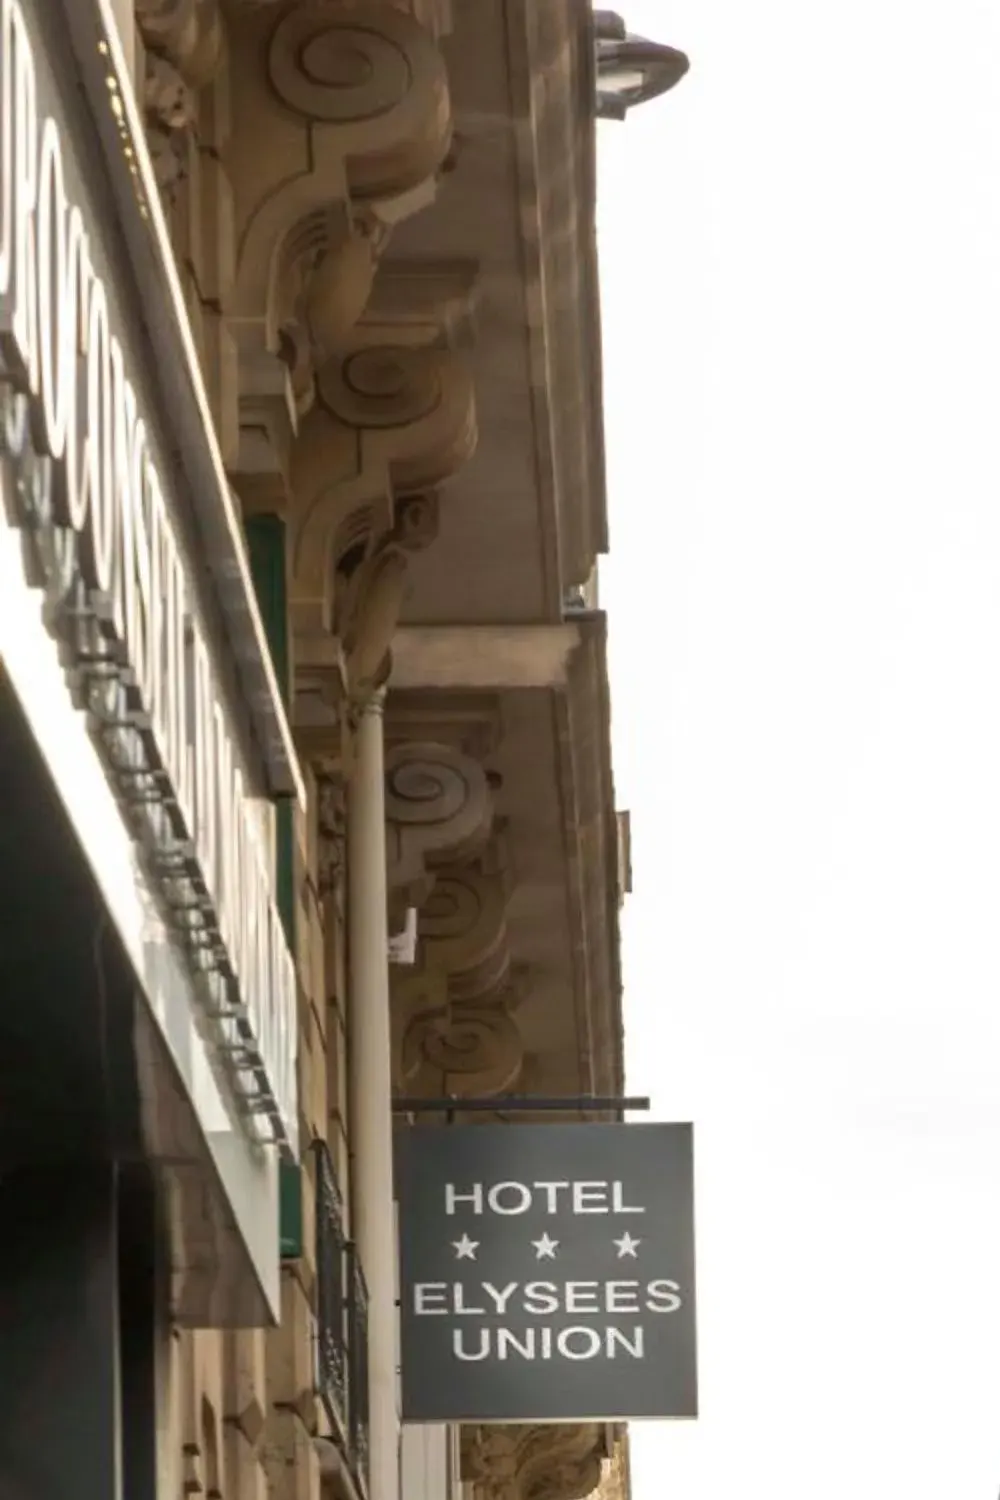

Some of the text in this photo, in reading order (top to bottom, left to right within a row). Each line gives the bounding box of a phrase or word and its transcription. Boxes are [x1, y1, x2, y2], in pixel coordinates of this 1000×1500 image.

[446, 1180, 645, 1215] HOTEL
[414, 1279, 681, 1315] ELYSEES
[453, 1326, 644, 1360] UNION
